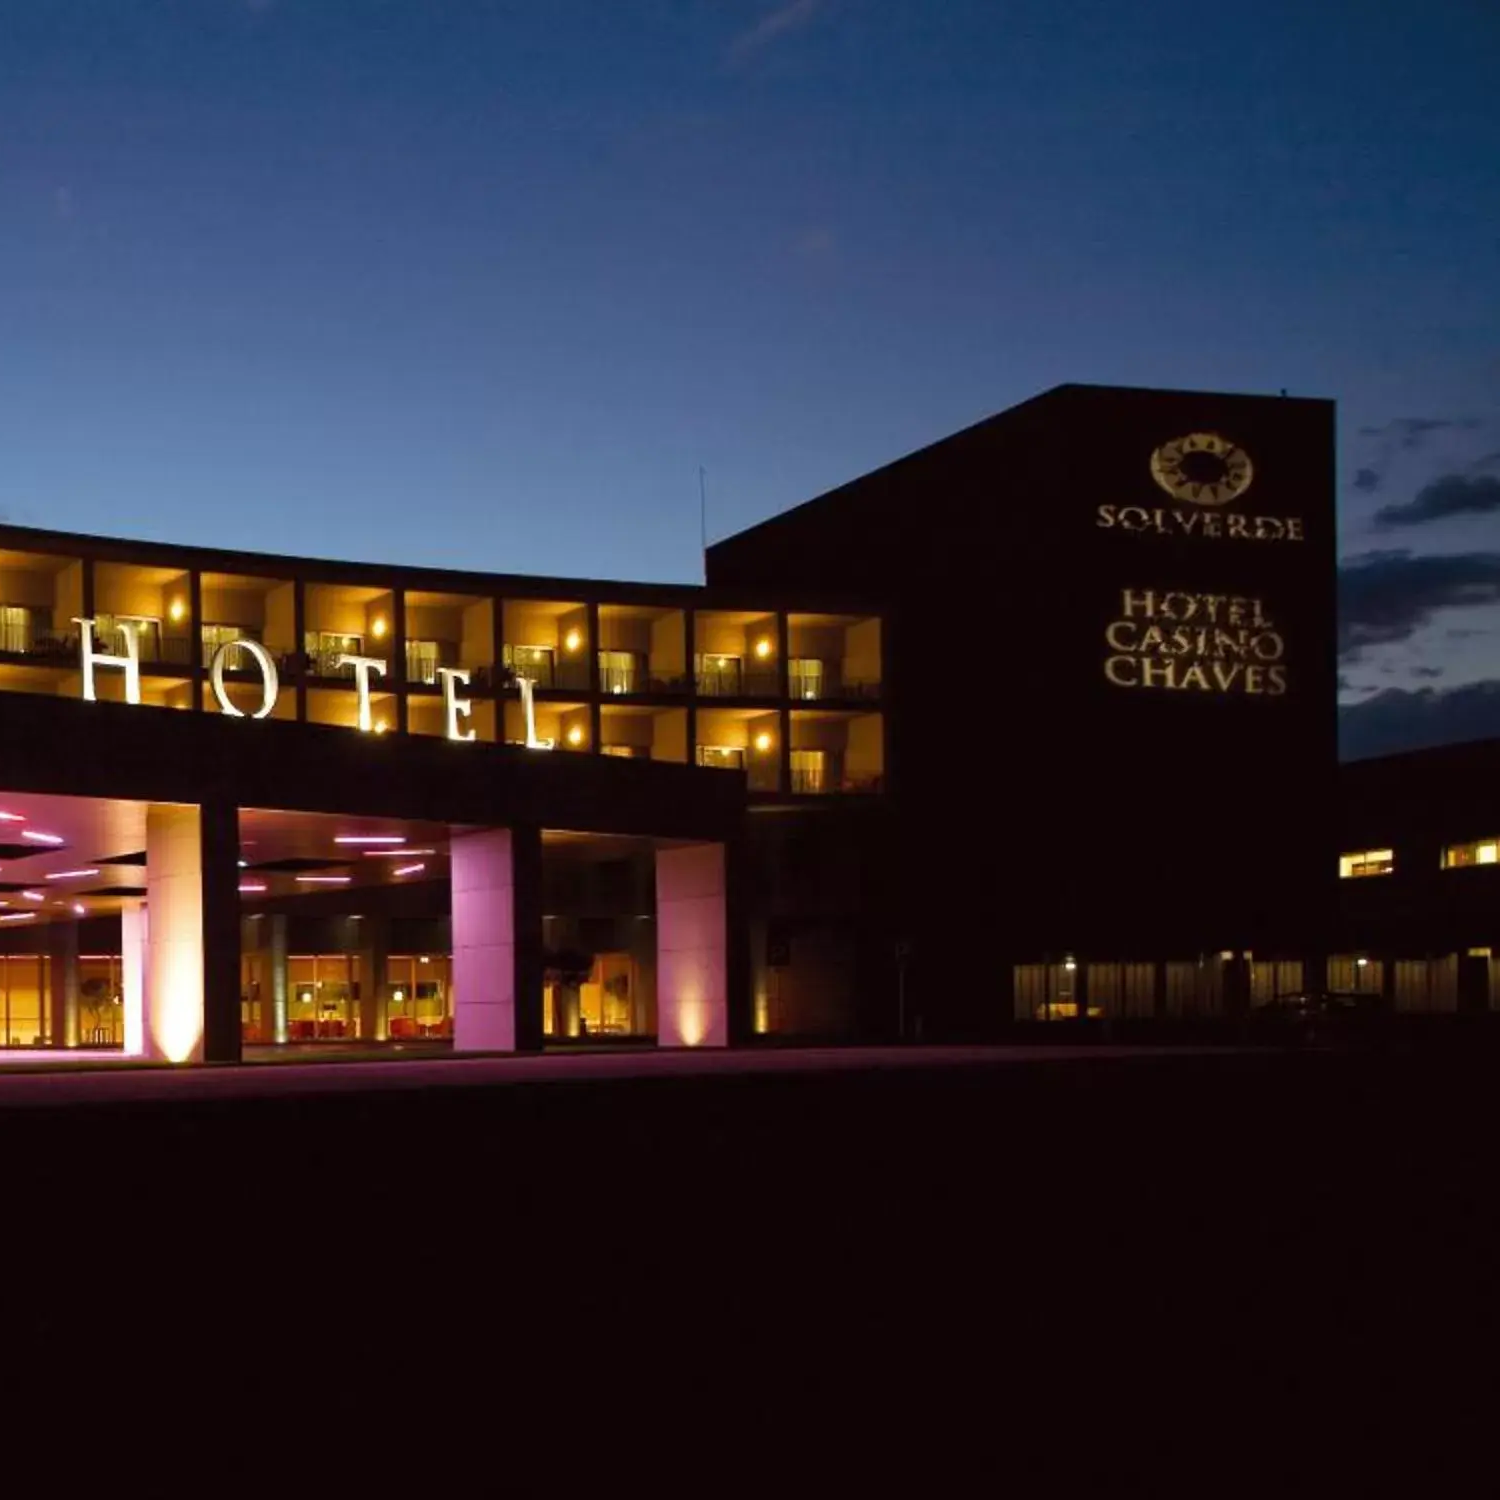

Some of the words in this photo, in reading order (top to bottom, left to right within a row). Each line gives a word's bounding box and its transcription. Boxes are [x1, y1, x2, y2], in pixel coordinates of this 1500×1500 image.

[1096, 504, 1304, 541] SOLVERDE
[1121, 588, 1273, 628] HOTEL
[1105, 621, 1284, 661] CASINO
[71, 617, 554, 750] HOTEL
[1104, 655, 1288, 696] CHAVES
